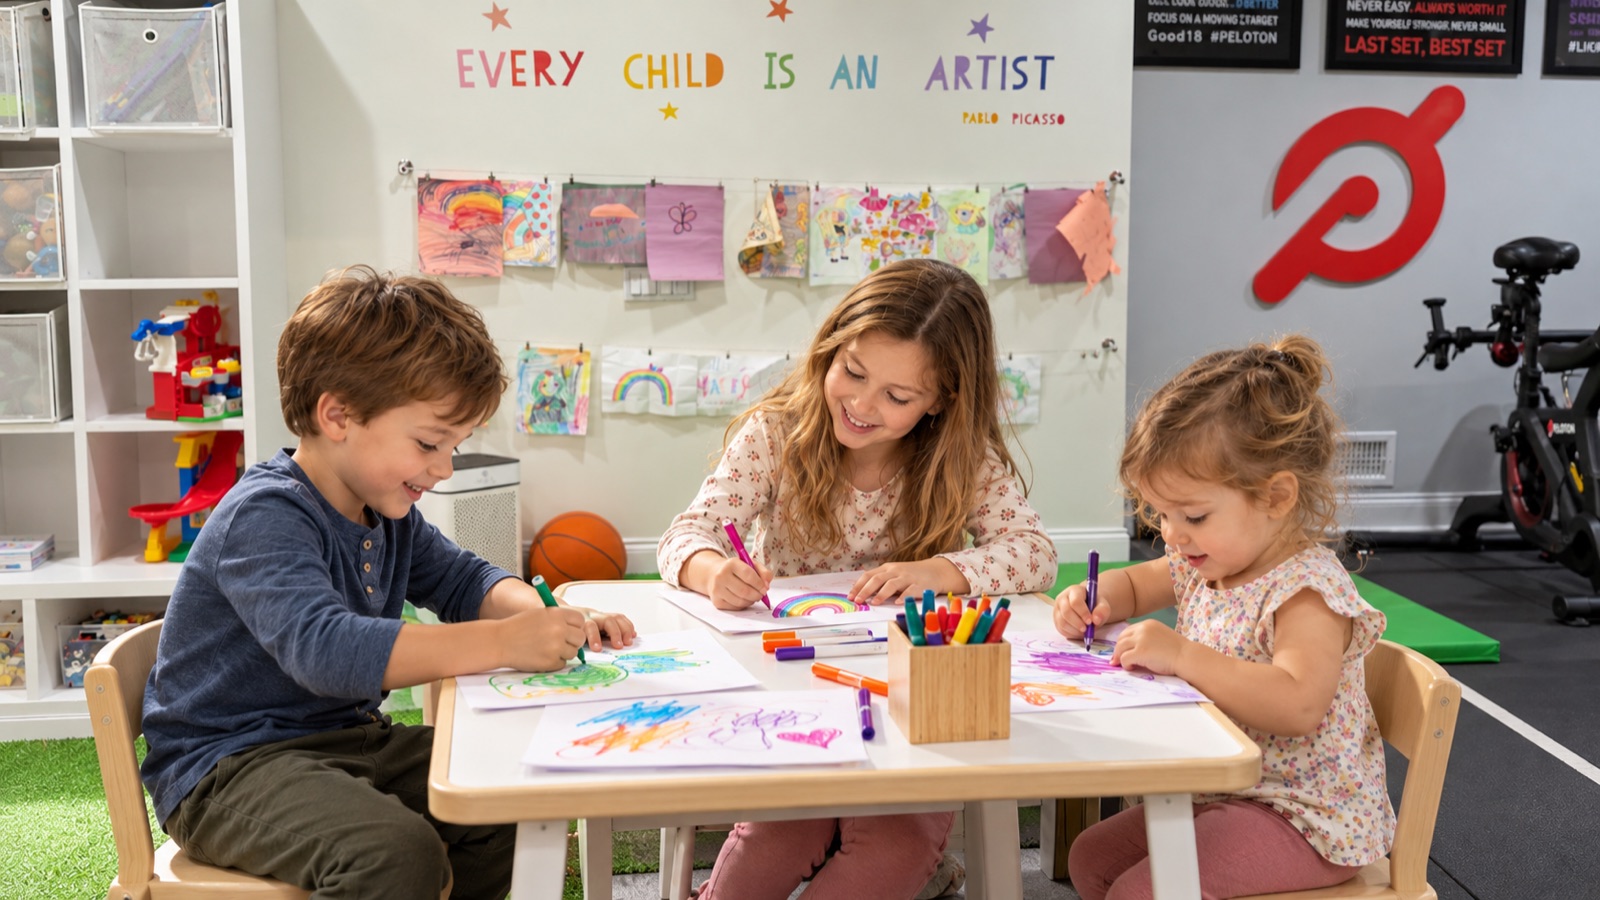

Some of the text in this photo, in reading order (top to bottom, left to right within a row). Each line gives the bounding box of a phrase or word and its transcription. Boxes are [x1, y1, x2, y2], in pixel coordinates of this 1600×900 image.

[1346, 0, 1382, 12] NEVER
[1415, 2, 1455, 14] ALWAYS
[1457, 3, 1494, 15] WORTH
[1497, 4, 1507, 16] IT
[1147, 12, 1178, 23] FOCUS
[1179, 12, 1193, 24] ON
[1194, 13, 1202, 24] A
[1203, 13, 1239, 25] MOVING
[1345, 17, 1370, 29] MAKE
[1371, 18, 1411, 30] YOURSELF
[1450, 20, 1478, 32] NEVER
[1479, 21, 1506, 33] SMALL
[1210, 30, 1278, 44] #PELOTON
[1345, 34, 1507, 58] LAST SET, BEST SET
[457, 49, 1055, 91] EVERY CHILD IS AN ARTIST
[963, 112, 1066, 126] PABLO PICASSO
